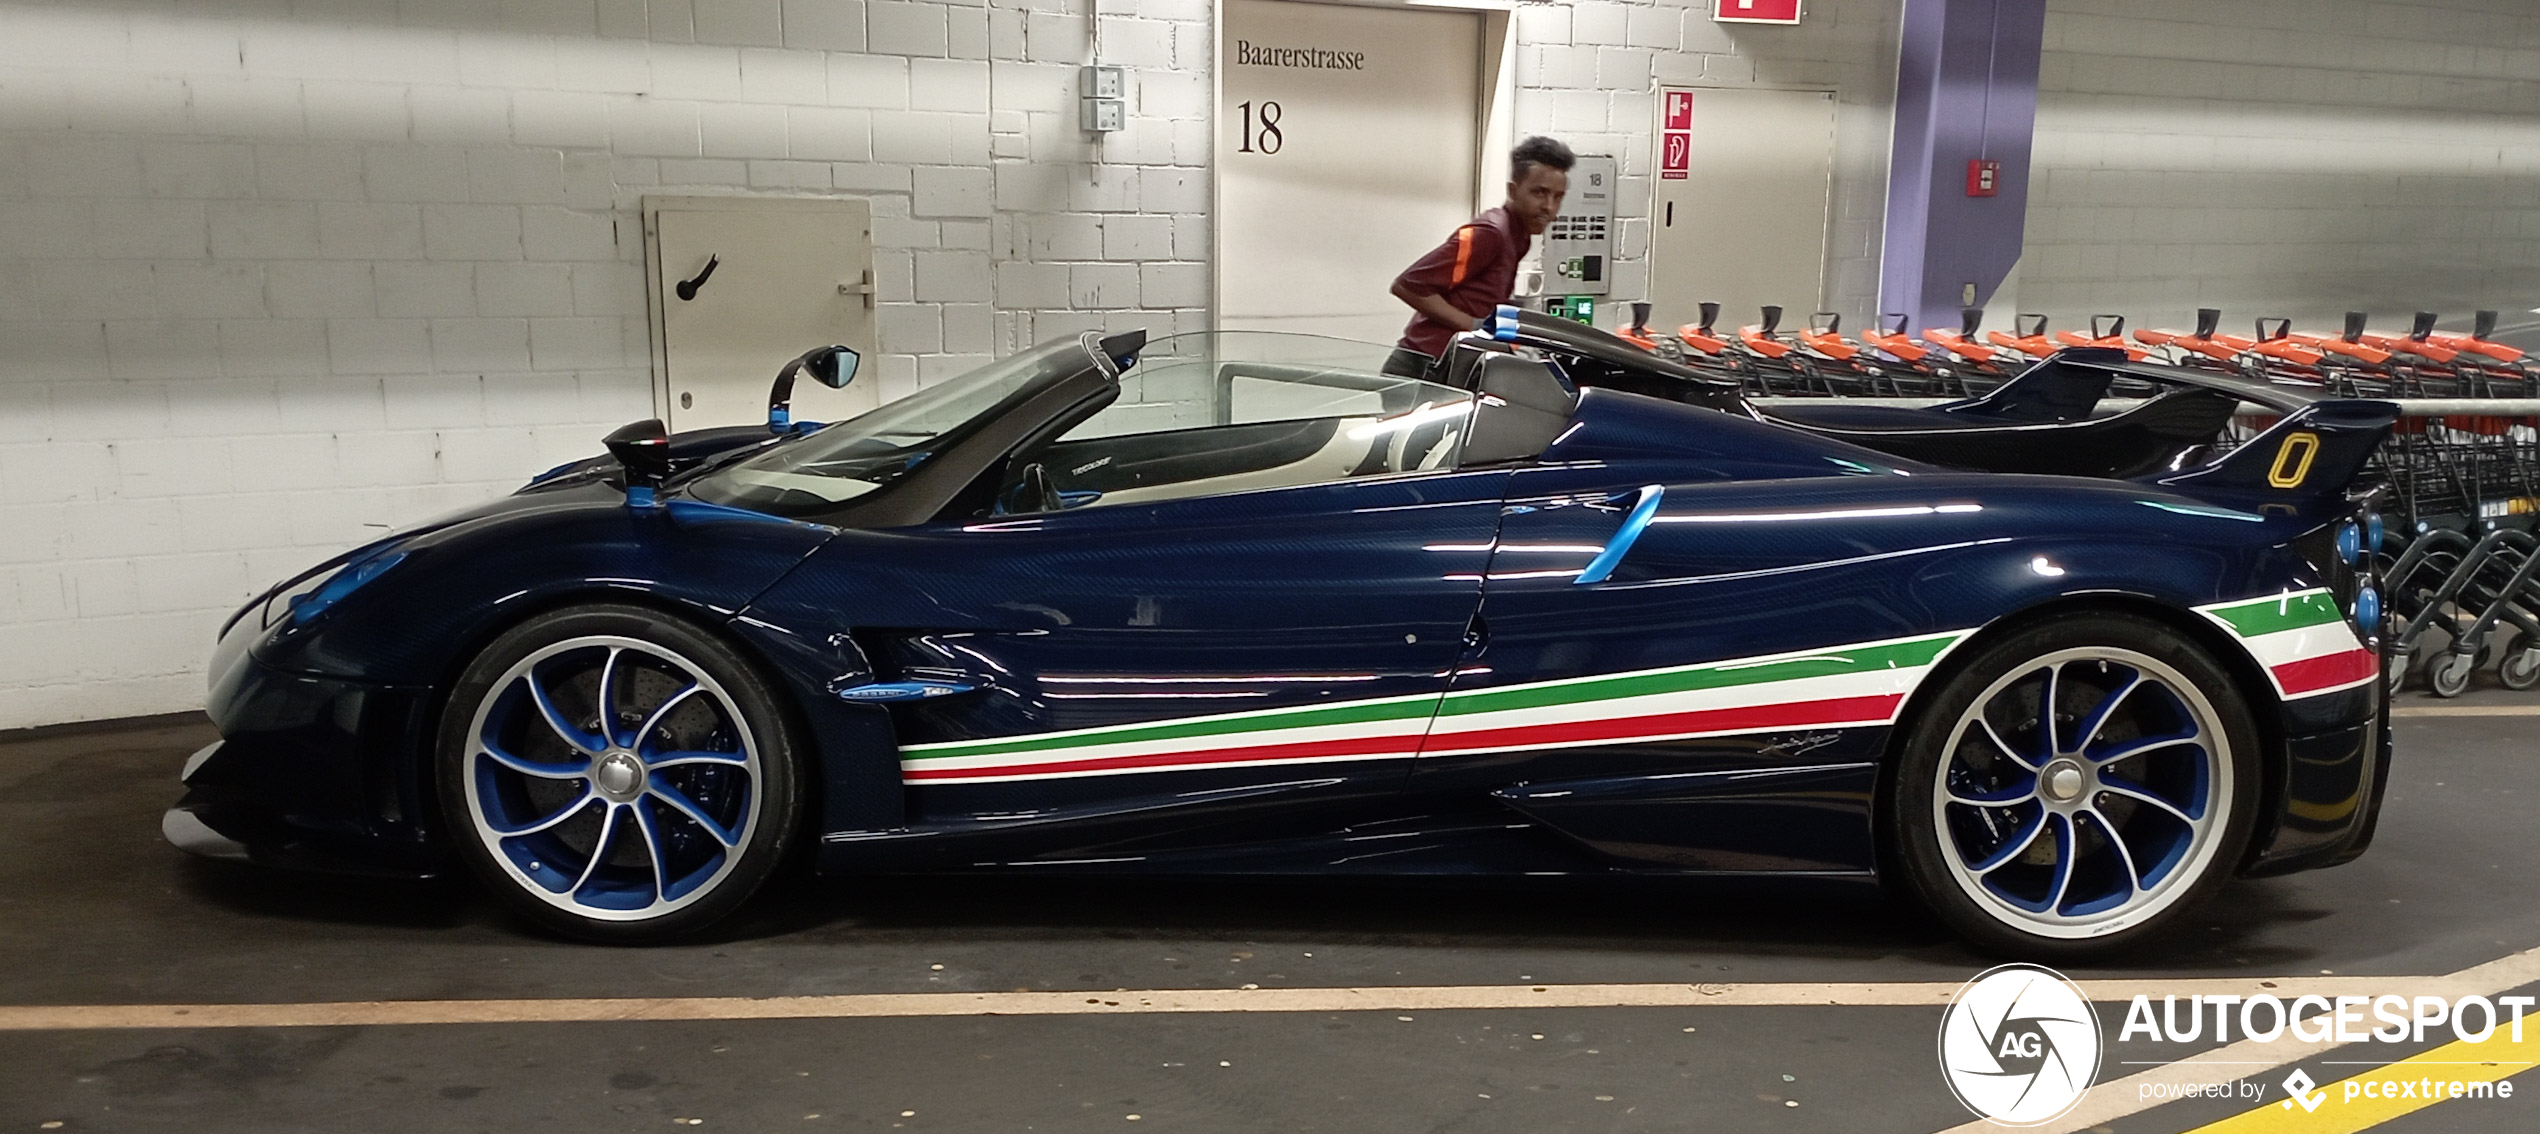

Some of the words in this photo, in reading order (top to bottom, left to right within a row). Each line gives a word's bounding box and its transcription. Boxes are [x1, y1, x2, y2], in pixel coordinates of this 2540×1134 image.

[1237, 40, 1364, 70] Baarerstrasse
[1237, 100, 1283, 155] 18
[1589, 172, 1602, 187] 18
